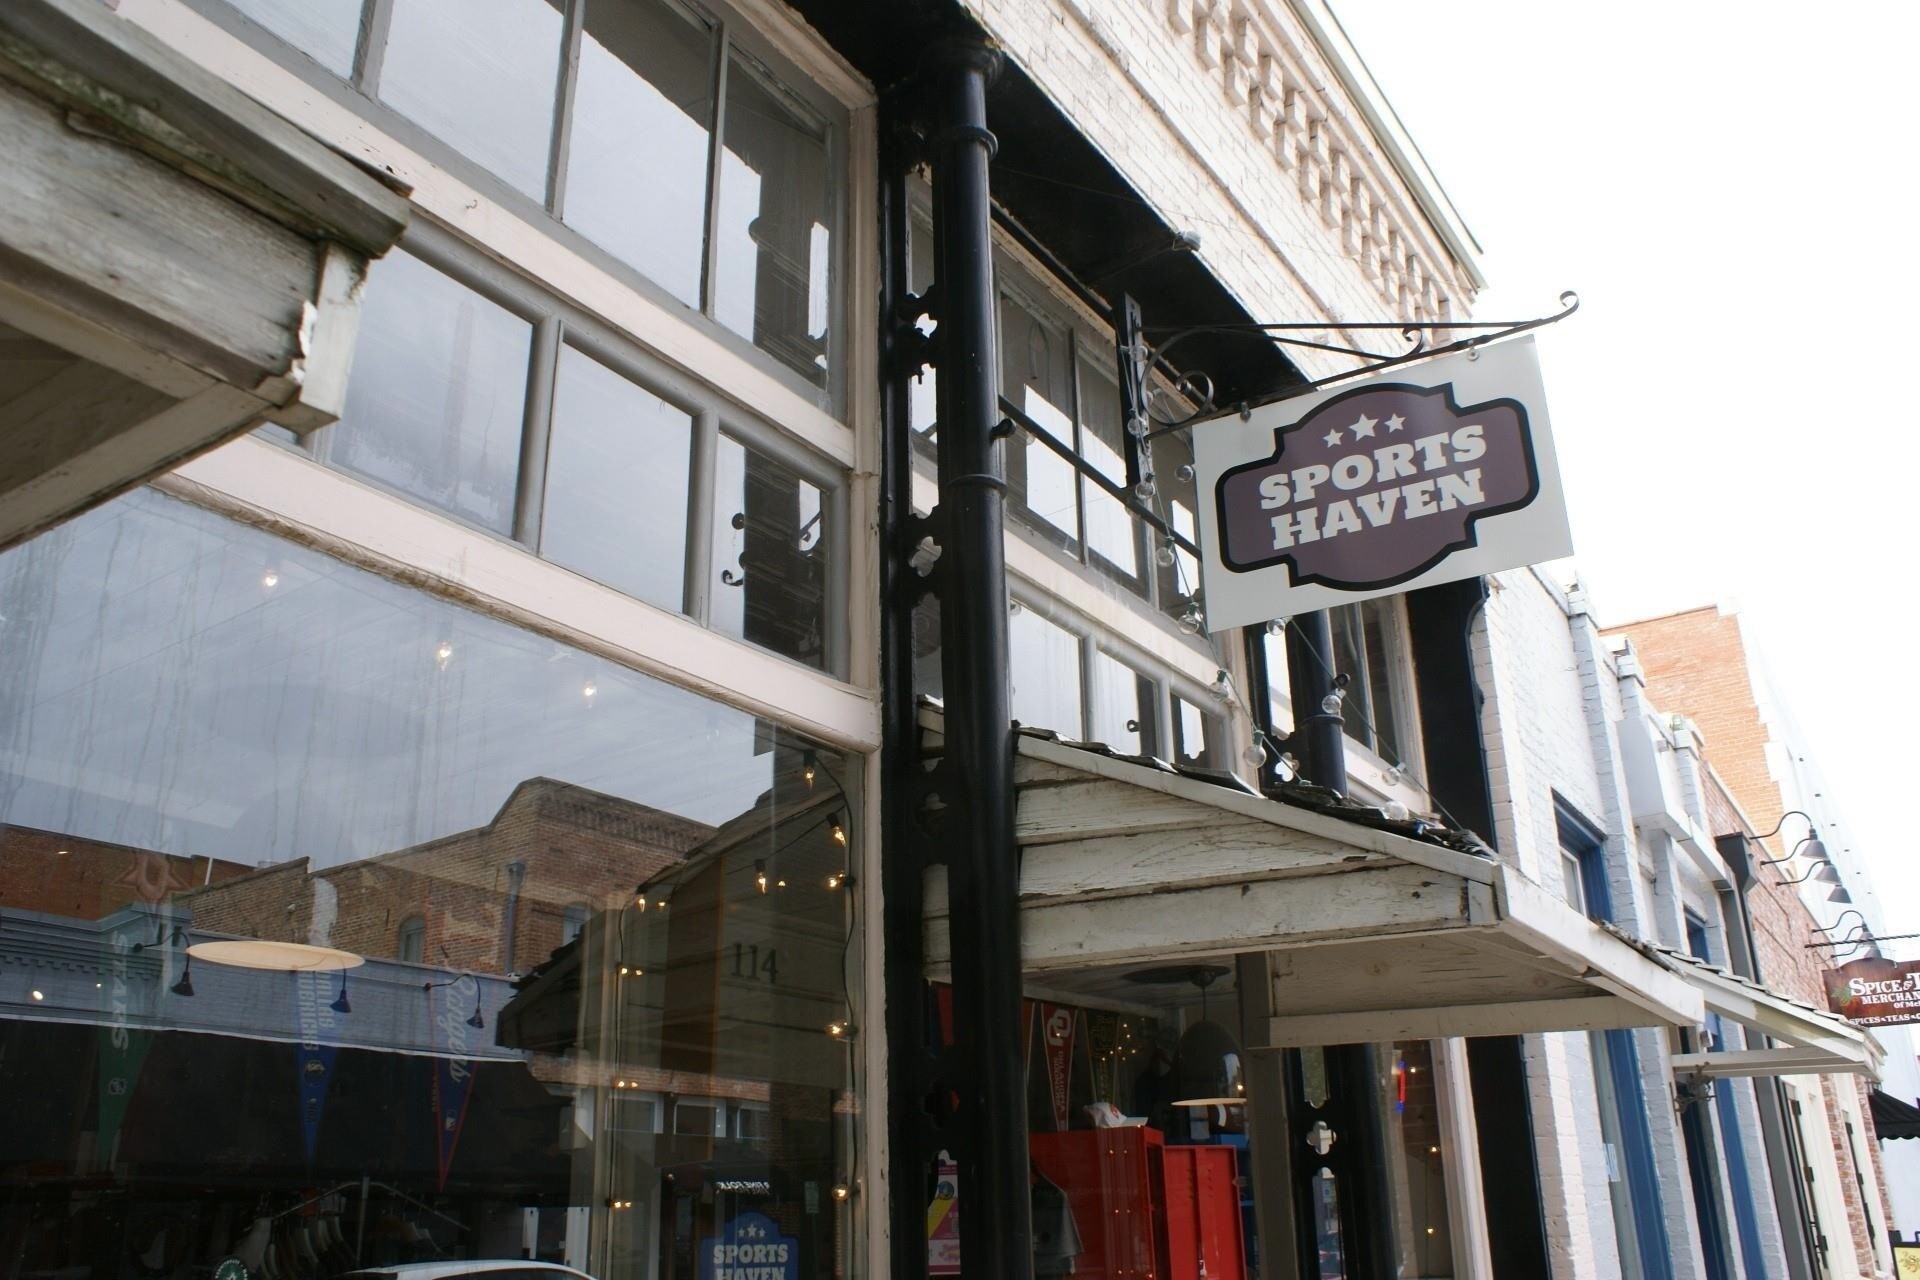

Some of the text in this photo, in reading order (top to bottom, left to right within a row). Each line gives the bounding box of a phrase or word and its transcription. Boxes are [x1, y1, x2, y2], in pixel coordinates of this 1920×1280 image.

[1259, 425, 1487, 510] SPORTS
[1270, 468, 1486, 550] HAVEN
[730, 943, 779, 984] 114
[110, 930, 129, 1050] STARS
[1848, 977, 1903, 997] SPICE
[437, 976, 477, 1083] Rangers
[1885, 1013, 1910, 1022] TEAS
[713, 1244, 788, 1264] SPORTS
[715, 1267, 786, 1280] HAVEN
